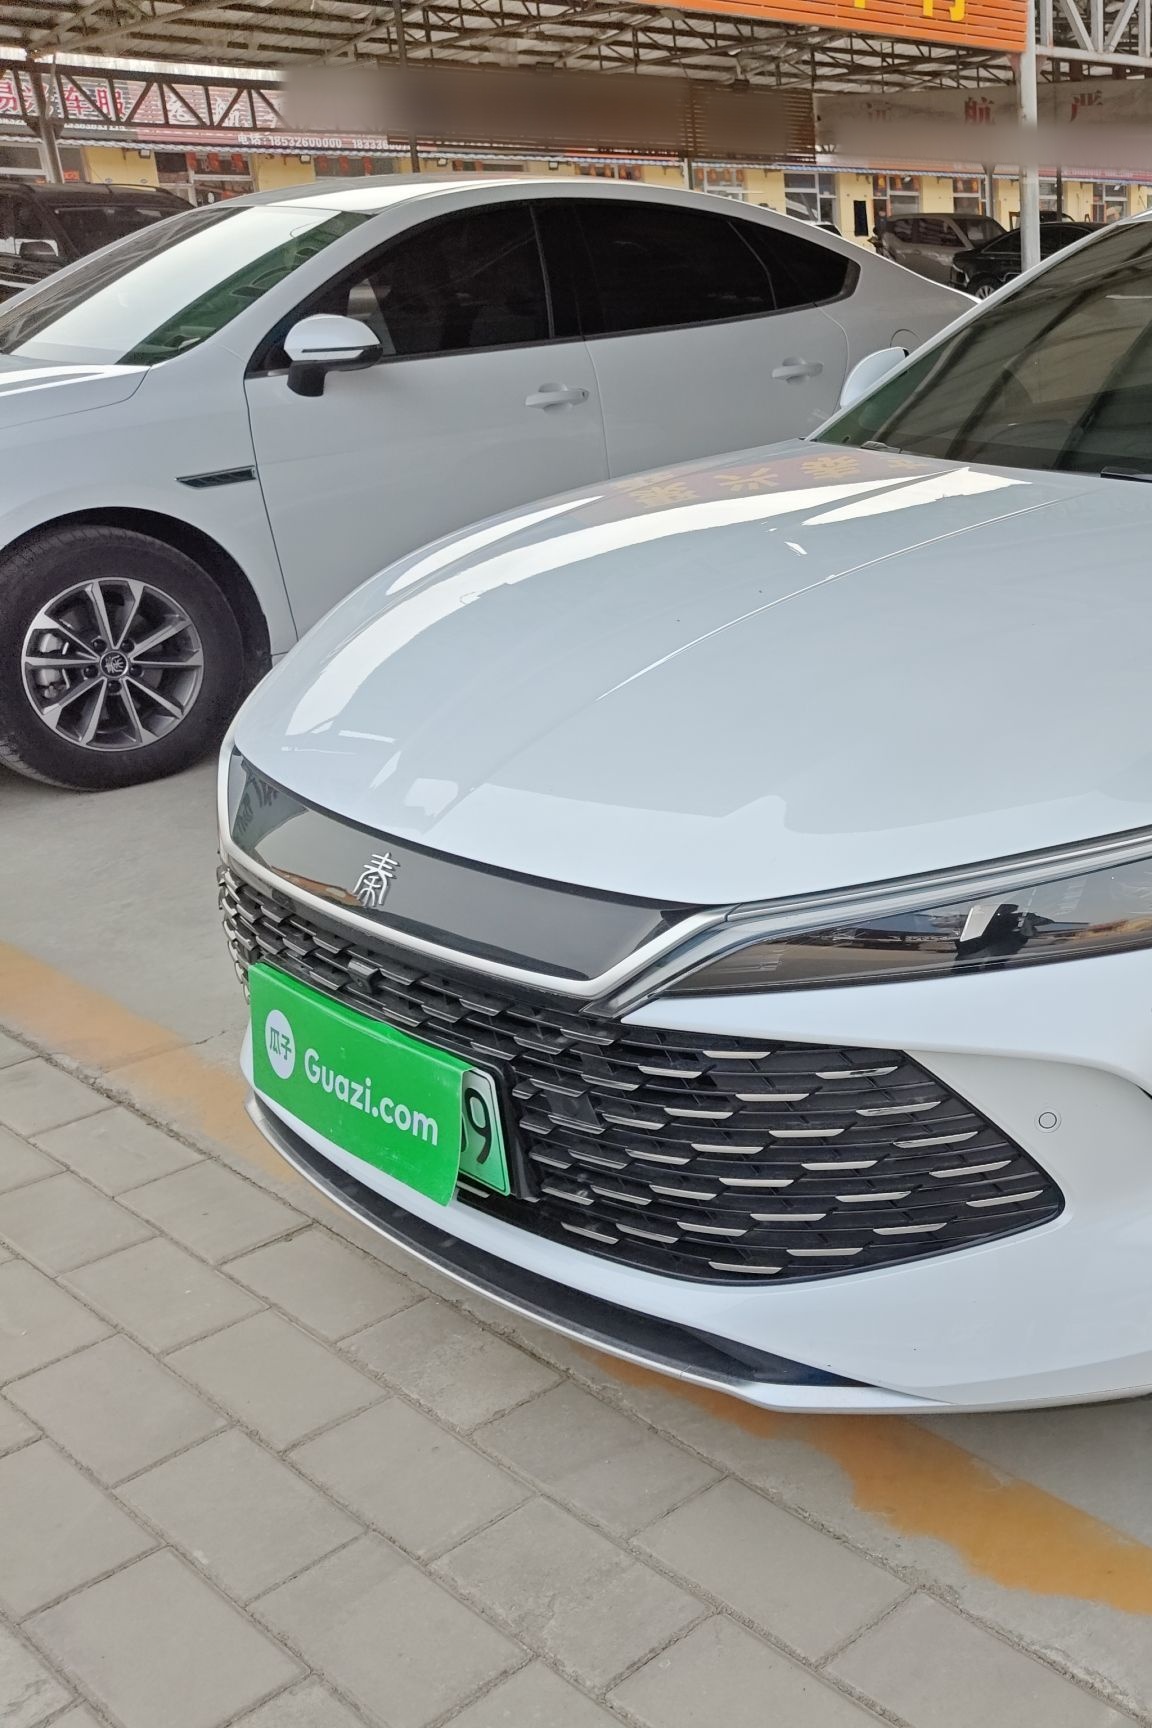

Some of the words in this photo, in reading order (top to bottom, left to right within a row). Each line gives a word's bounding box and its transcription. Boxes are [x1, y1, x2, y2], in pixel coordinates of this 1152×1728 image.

[269, 1027, 293, 1061] 瓜子
[304, 1048, 438, 1146] Guazi.com
[461, 1088, 492, 1165] 9
